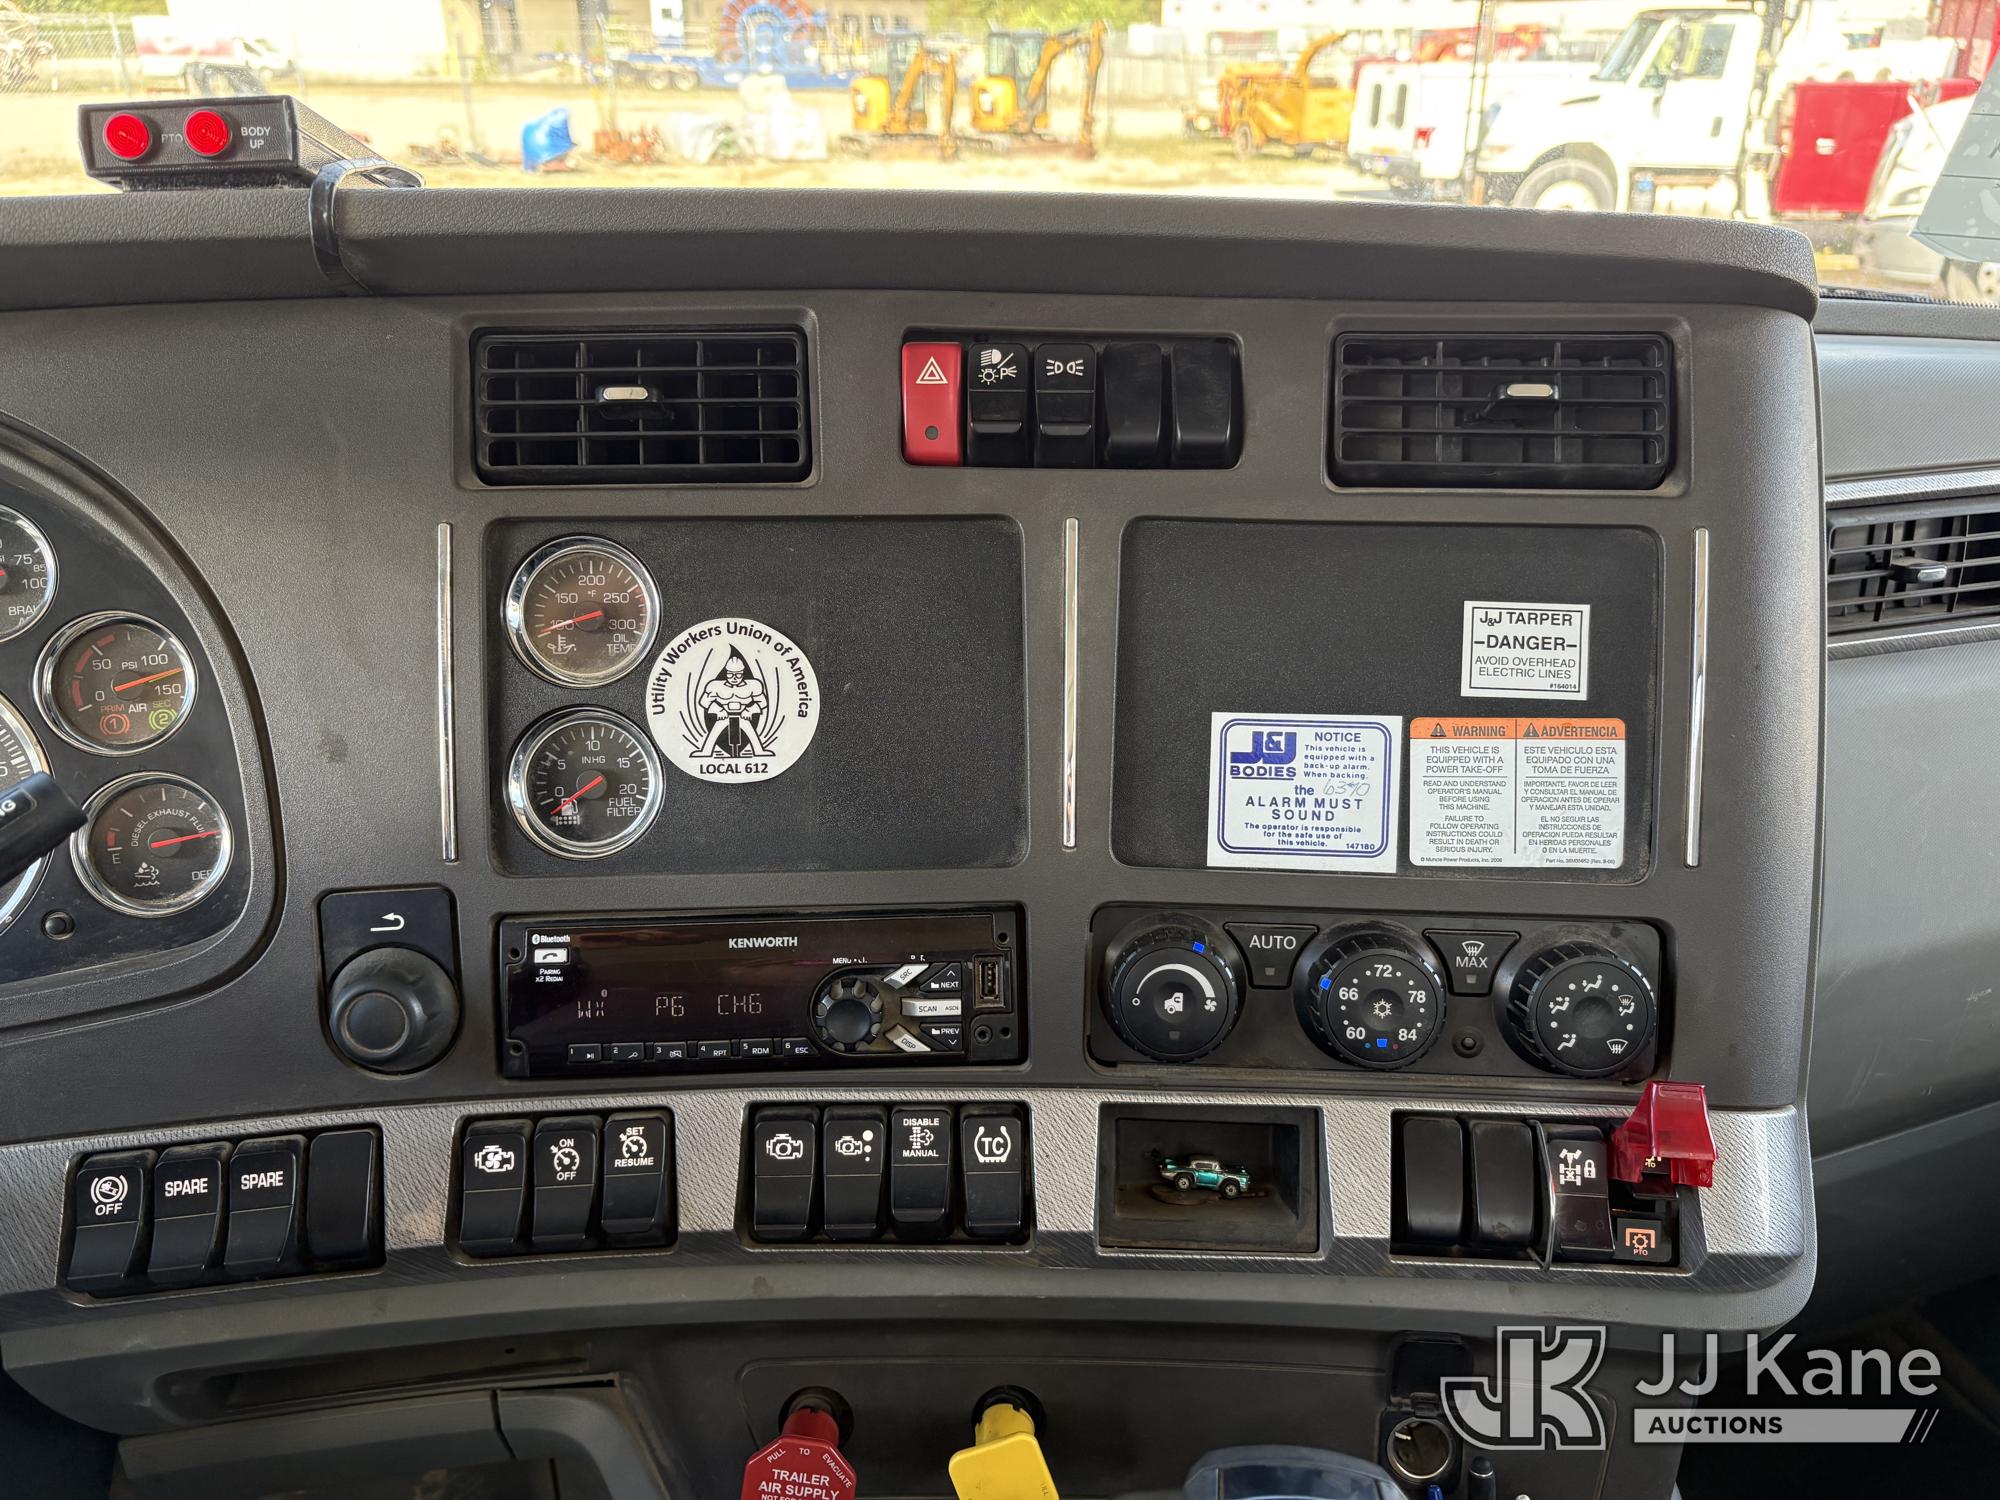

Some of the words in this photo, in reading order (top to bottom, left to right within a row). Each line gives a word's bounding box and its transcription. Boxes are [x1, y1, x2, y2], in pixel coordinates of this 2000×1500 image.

[240, 126, 271, 136] BODY
[161, 133, 184, 144] PTO
[249, 139, 265, 149] UP
[14, 554, 33, 565] 75
[578, 575, 606, 586] 200
[555, 592, 578, 604] 150
[603, 592, 630, 604] 250
[1480, 610, 1503, 627] J&J
[1506, 611, 1573, 627] TARPER
[608, 619, 636, 631] 300
[613, 633, 629, 643] OIL
[92, 659, 112, 671] 50
[121, 661, 138, 670] PSI
[140, 653, 168, 666] 100
[1475, 655, 1509, 666] AVOID
[1512, 656, 1576, 668] OVERHEAD
[651, 667, 673, 716] Utility
[662, 625, 722, 665] Workers
[726, 622, 772, 645] Union
[773, 642, 792, 656] of
[786, 656, 813, 719] America
[1479, 666, 1536, 678] ELECTRIC
[1538, 669, 1572, 679] LINES
[95, 690, 105, 702] 0
[155, 683, 181, 695] 150
[100, 704, 125, 713] PRIM
[128, 703, 148, 713] AIR
[152, 699, 171, 708] SEC
[1452, 725, 1506, 737] WARNING
[1541, 726, 1617, 737] ADVERTENCIA
[1314, 732, 1362, 743] NOTICE
[585, 740, 601, 751] 10
[1230, 731, 1297, 765] J&J
[1430, 746, 1450, 754] THIS
[1452, 746, 1489, 754] VEHICLE
[1491, 746, 1500, 754] IS
[1524, 746, 1546, 754] ESTE
[1548, 746, 1593, 754] VEHICULO
[1595, 747, 1617, 755] ESTA
[557, 760, 566, 770] 5
[616, 757, 630, 769] 15
[1304, 754, 1346, 762] equipped
[1426, 756, 1471, 764] EQUIPPED
[1472, 756, 1495, 764] WITH
[1526, 756, 1571, 764] EQUIPADO
[1573, 756, 1594, 764] CON
[1596, 756, 1615, 764] UNA
[699, 763, 742, 775] LOCAL
[744, 762, 769, 774] 612
[1229, 765, 1297, 778] BODIES
[1304, 762, 1340, 771] back-up
[1532, 766, 1558, 774] TOMA
[1560, 766, 1573, 774] DE
[1574, 766, 1610, 774] FUERZA
[555, 786, 565, 797] 0
[619, 784, 637, 795] 20
[1294, 784, 1315, 796] the
[608, 797, 637, 807] FUEL
[1245, 796, 1306, 808] ALARM
[1314, 798, 1363, 810] MUST
[1272, 809, 1335, 822] SOUND
[131, 820, 149, 847] DIESEL
[147, 808, 191, 821] EXHAUST
[1262, 824, 1299, 832] operator
[1311, 825, 1362, 834] responsible
[540, 935, 571, 943] Bluetooth
[729, 936, 798, 949] KENWORTH
[1249, 935, 1297, 949] AUTO
[1455, 956, 1488, 968] MAX
[899, 968, 913, 981] SRC
[1374, 964, 1393, 977] 72
[1339, 987, 1358, 1000] 66
[1408, 990, 1426, 1003] 78
[918, 1005, 938, 1013] SCAN
[1346, 1026, 1366, 1039] 60
[1398, 1028, 1417, 1041] 84
[901, 1037, 917, 1049] DISP
[713, 1049, 727, 1057] RPT
[752, 1047, 770, 1055] RDM
[795, 1046, 809, 1054] ESC
[903, 1118, 940, 1127] DISABLE
[625, 1126, 645, 1136] SET
[559, 1138, 575, 1148] ON
[981, 1137, 1005, 1155] TC
[902, 1149, 939, 1158] MANUAL
[614, 1157, 655, 1168] RESUME
[240, 1171, 284, 1190] SPARE
[556, 1171, 577, 1181] OFF
[164, 1178, 208, 1197] SPARE
[94, 1203, 123, 1216] OFF
[1633, 1248, 1649, 1256] PTO
[766, 1448, 787, 1464] PULL
[822, 1453, 853, 1488] EVACUATE
[772, 1468, 830, 1487] TRAILER
[758, 1481, 782, 1494] AIR
[785, 1484, 840, 1500] SUPPLY
